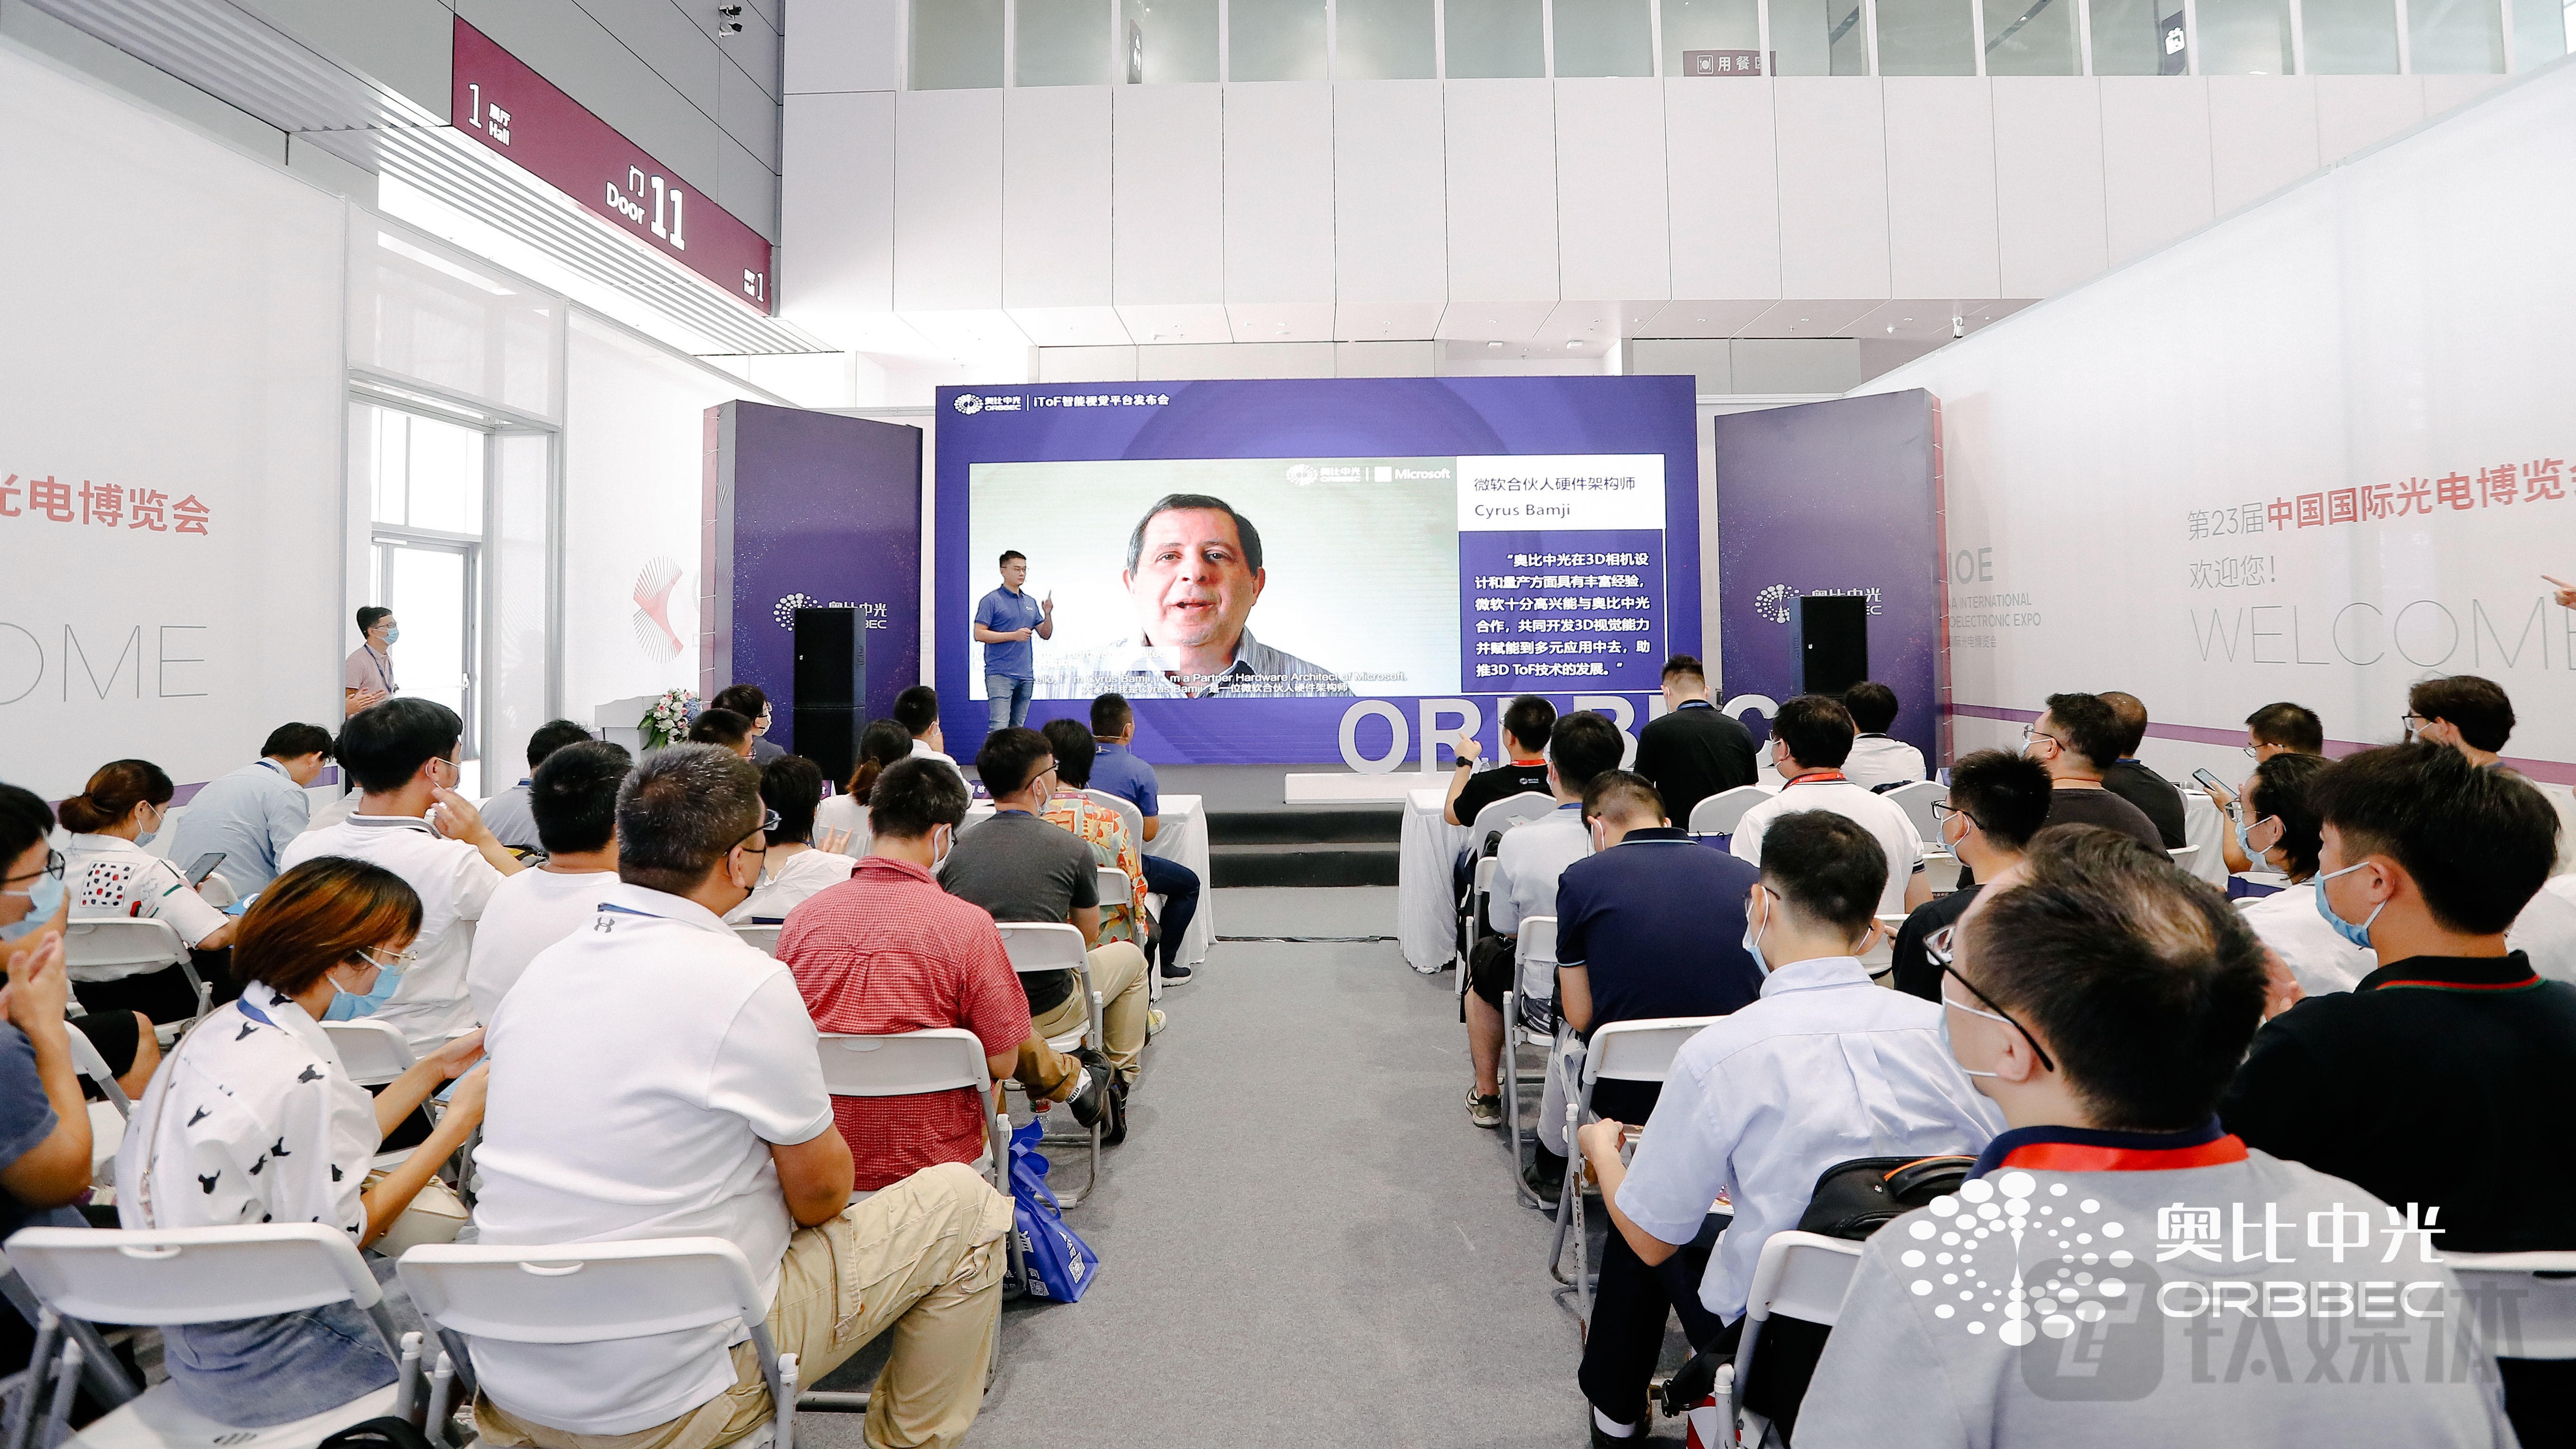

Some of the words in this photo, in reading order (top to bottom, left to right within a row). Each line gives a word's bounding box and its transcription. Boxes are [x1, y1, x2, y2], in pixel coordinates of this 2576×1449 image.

[468, 83, 482, 129] 1
[488, 102, 511, 127] 展厅
[488, 121, 510, 146] Hall
[606, 181, 645, 225] Door
[628, 165, 645, 197] 门
[650, 175, 685, 251] 11
[757, 272, 765, 302] 1
[1394, 468, 1450, 480] Microsoft
[1474, 477, 1635, 491] 微软合伙人硬件架构师
[1475, 505, 1519, 519] Cyrus
[1526, 503, 1570, 518] Bamji
[2188, 457, 2576, 540] 第23届中国国际光电博览
[1474, 596, 1650, 611] 微软十分高兴能与奥比中光
[1960, 593, 2032, 609] INTERNATIONAL
[2014, 612, 2042, 627] EXPO
[2190, 596, 2576, 671] WELCOM
[1034, 675, 1057, 685] ello,
[1086, 674, 1117, 685] Cyrus
[1121, 674, 1152, 685] Bamji,
[1193, 673, 1233, 683] Partner
[1235, 673, 1288, 682] Hardware
[1291, 672, 1338, 682] Architect
[1340, 671, 1352, 681] of
[1354, 671, 1408, 681] Microsoft.
[1338, 694, 1778, 775] ORBC
